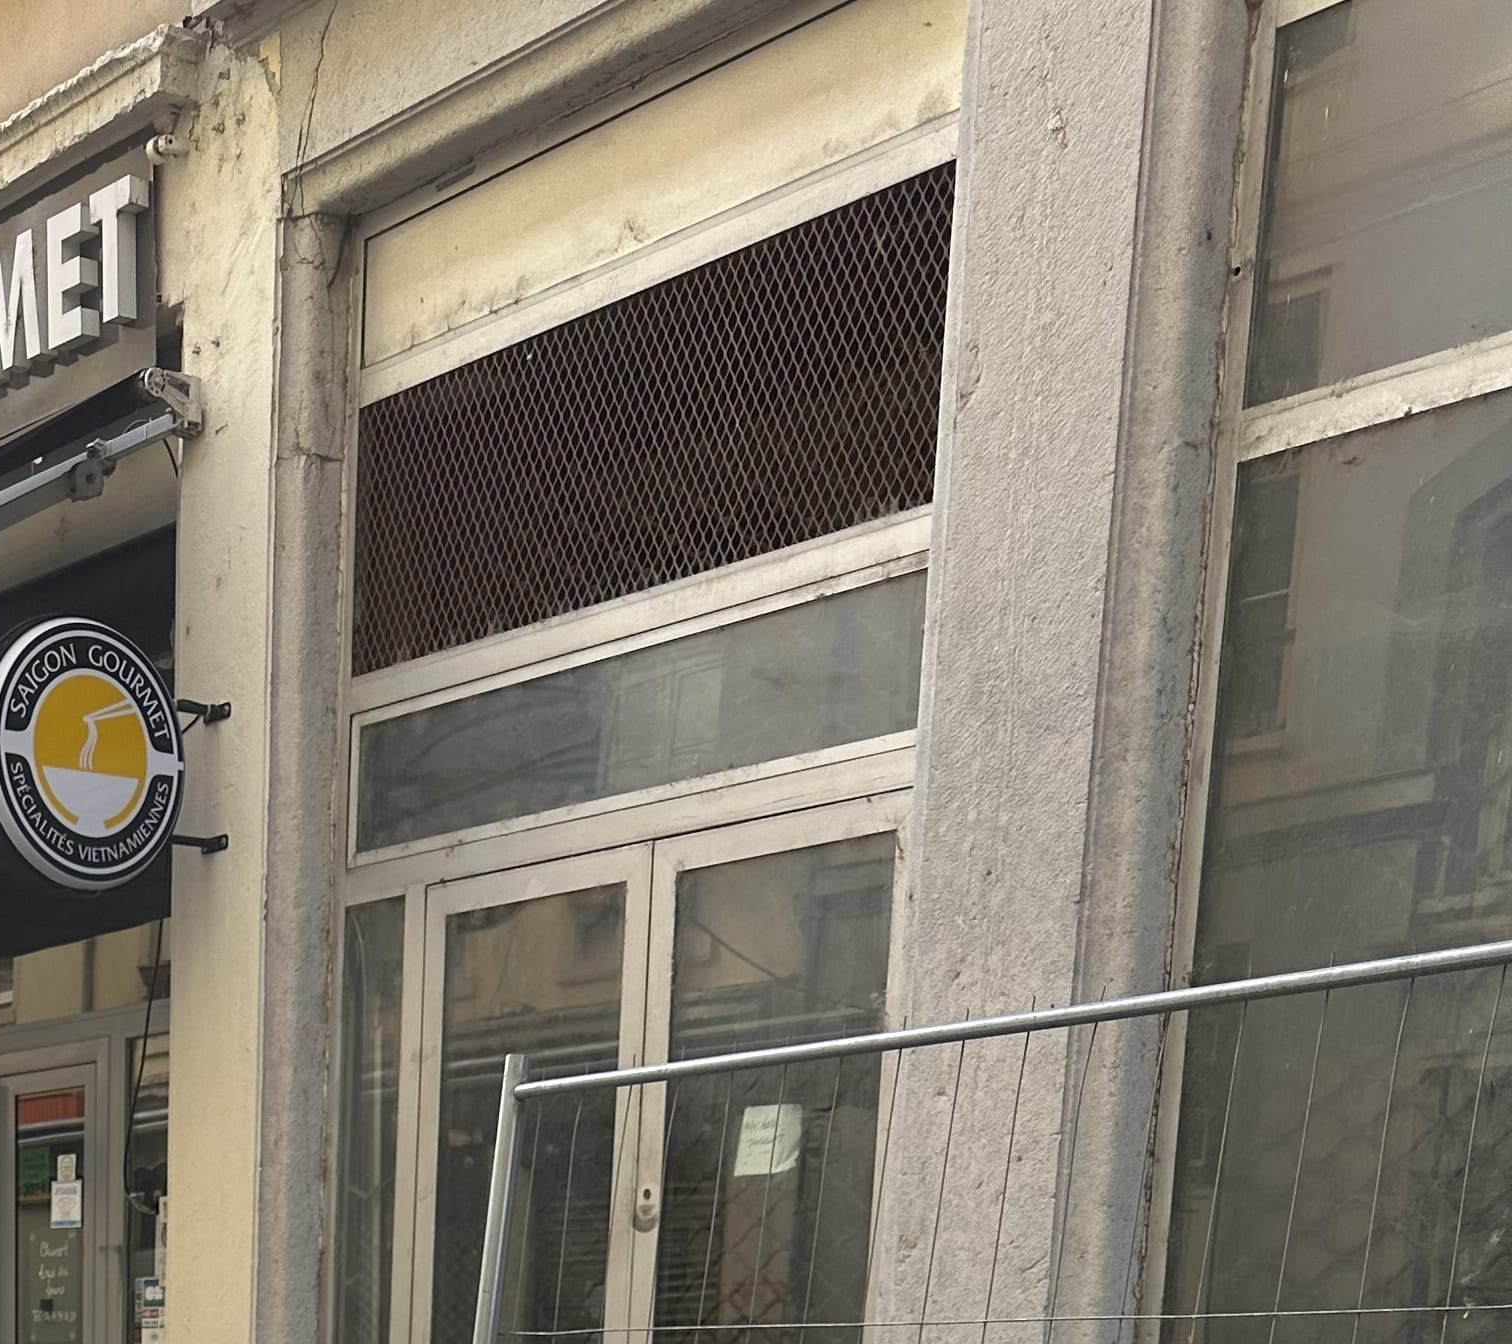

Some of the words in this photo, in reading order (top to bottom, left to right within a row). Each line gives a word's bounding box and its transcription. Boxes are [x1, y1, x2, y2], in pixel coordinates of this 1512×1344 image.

[10, 642, 77, 719] SAIGON
[88, 644, 171, 740] GOURMET
[10, 761, 74, 856] SPÉCIALITÉS
[78, 781, 169, 863] VIETNAMIENNES
